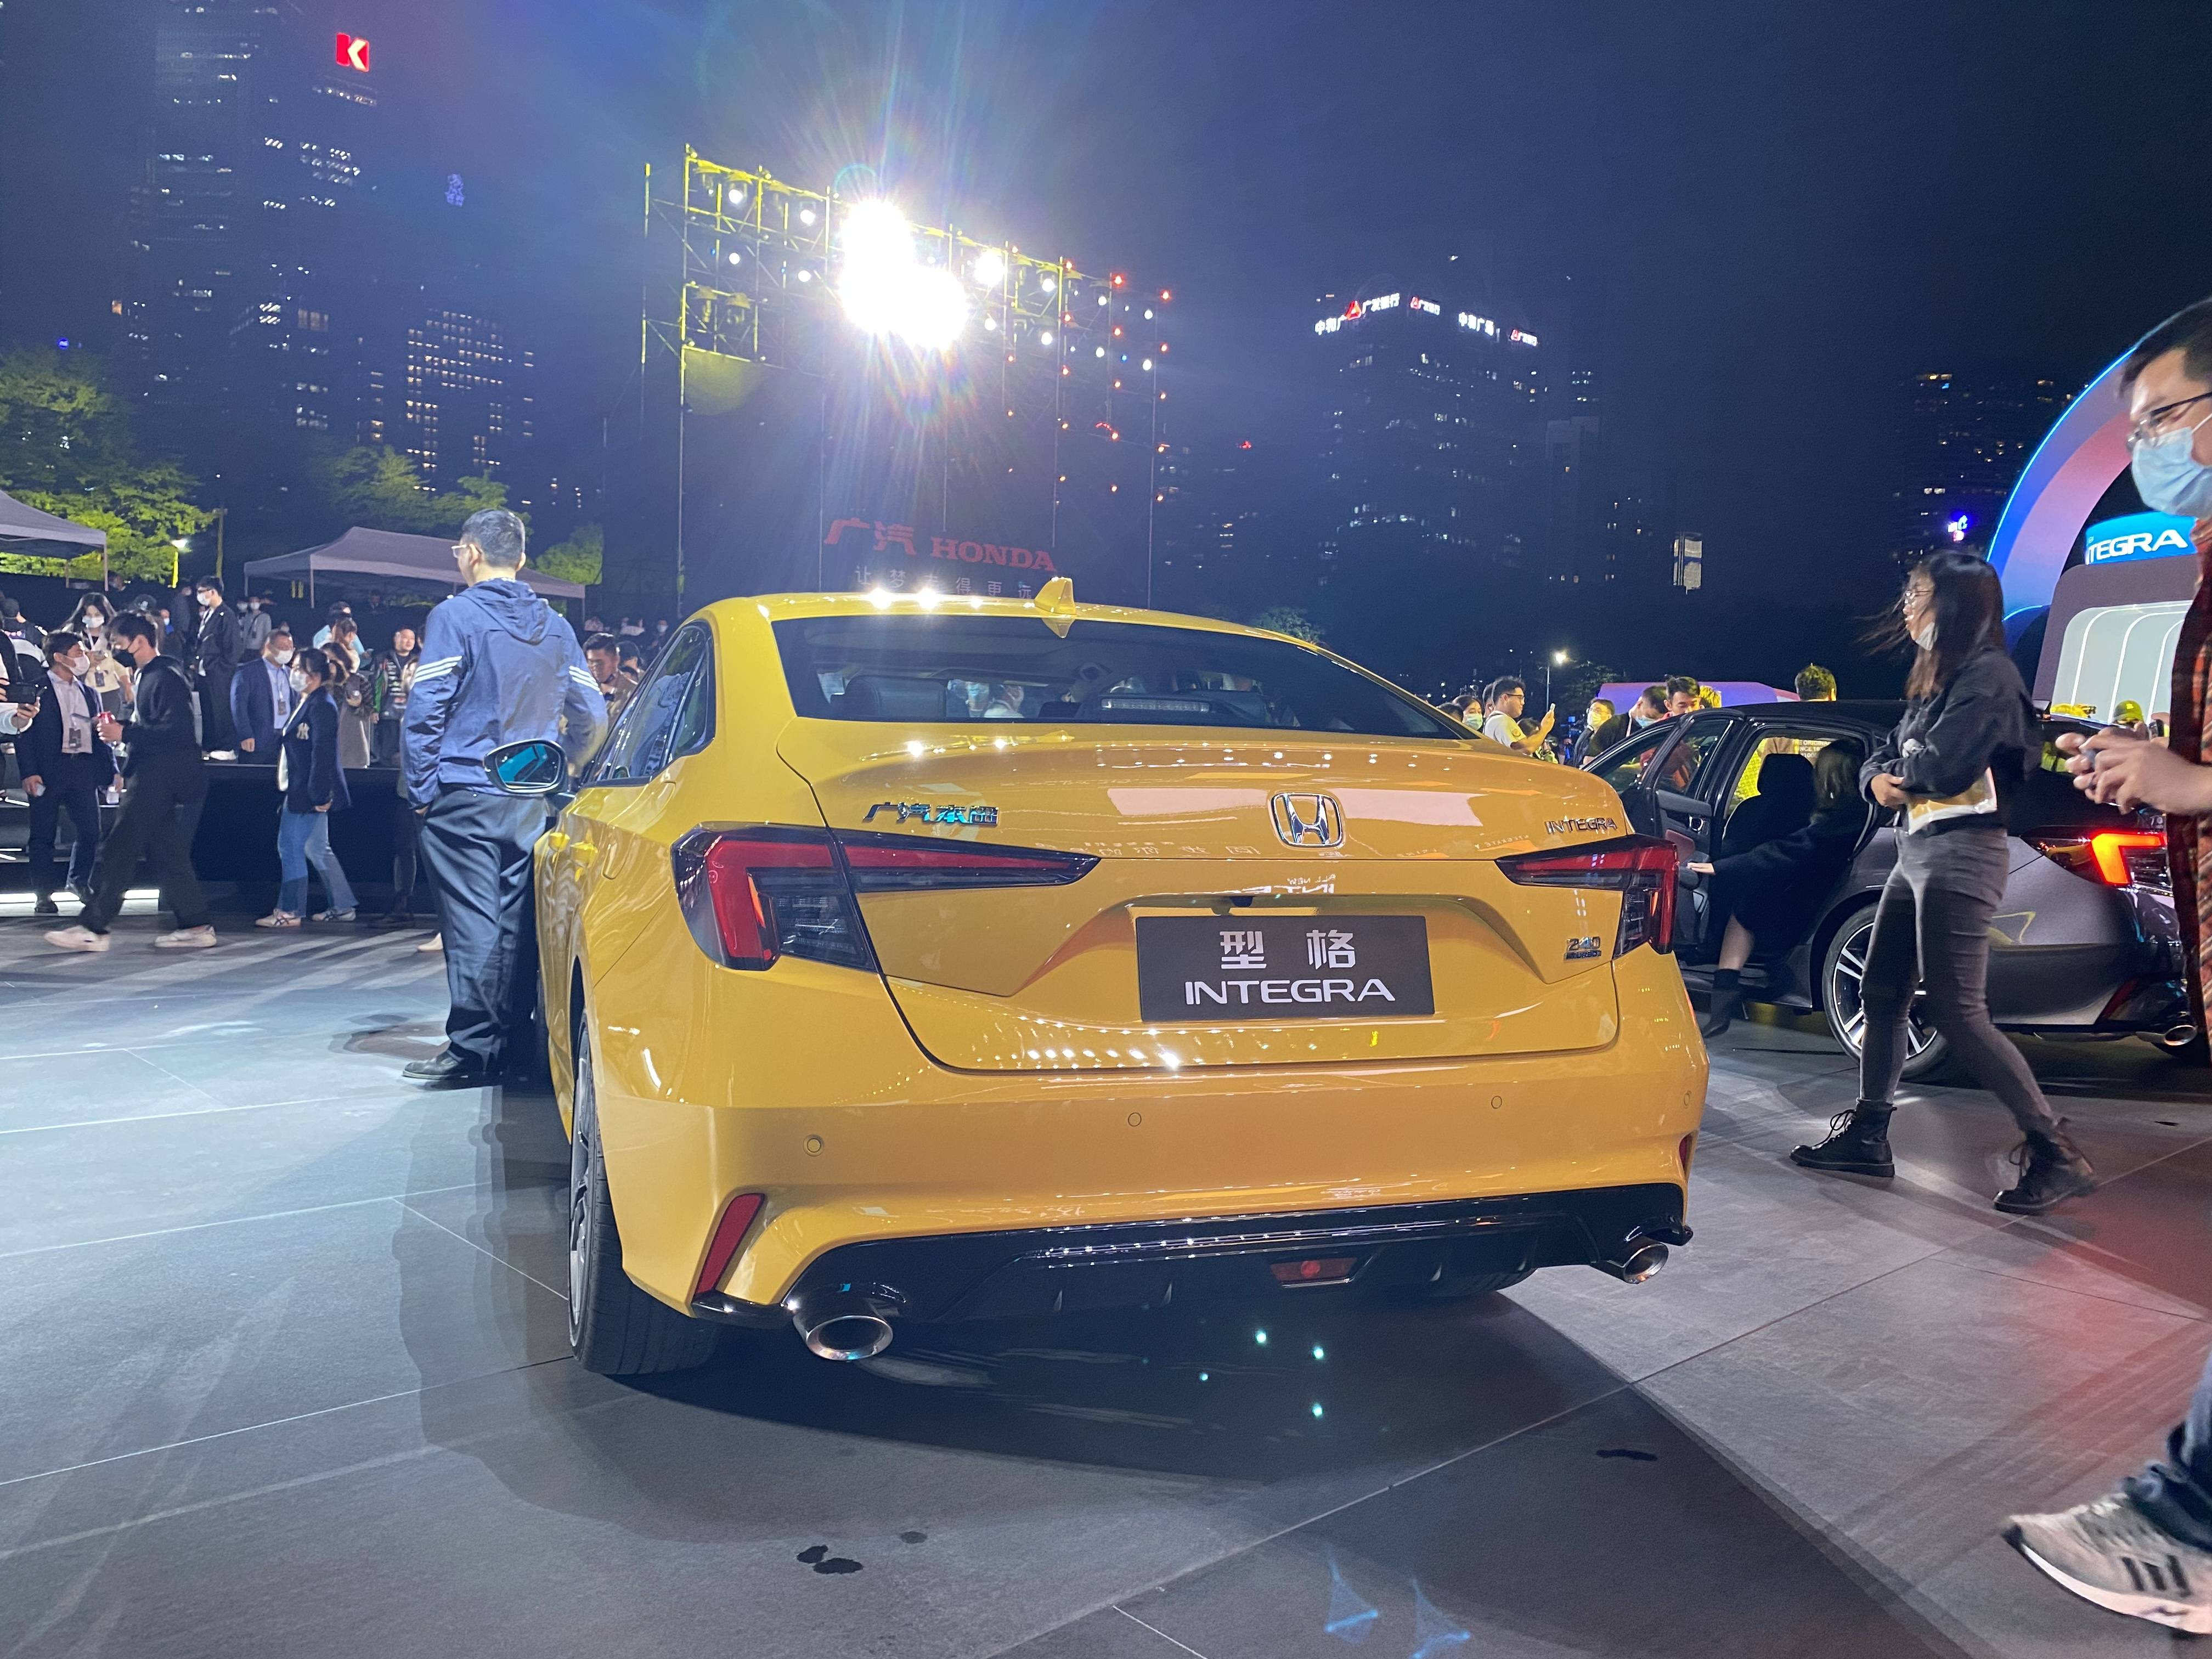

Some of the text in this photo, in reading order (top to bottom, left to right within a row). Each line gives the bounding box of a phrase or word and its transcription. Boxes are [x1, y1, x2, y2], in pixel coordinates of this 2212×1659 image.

[824, 517, 1057, 572] 广汽 HONDA
[1545, 817, 1617, 834] INTEGRA
[1185, 979, 1396, 1005] INTEGRA
